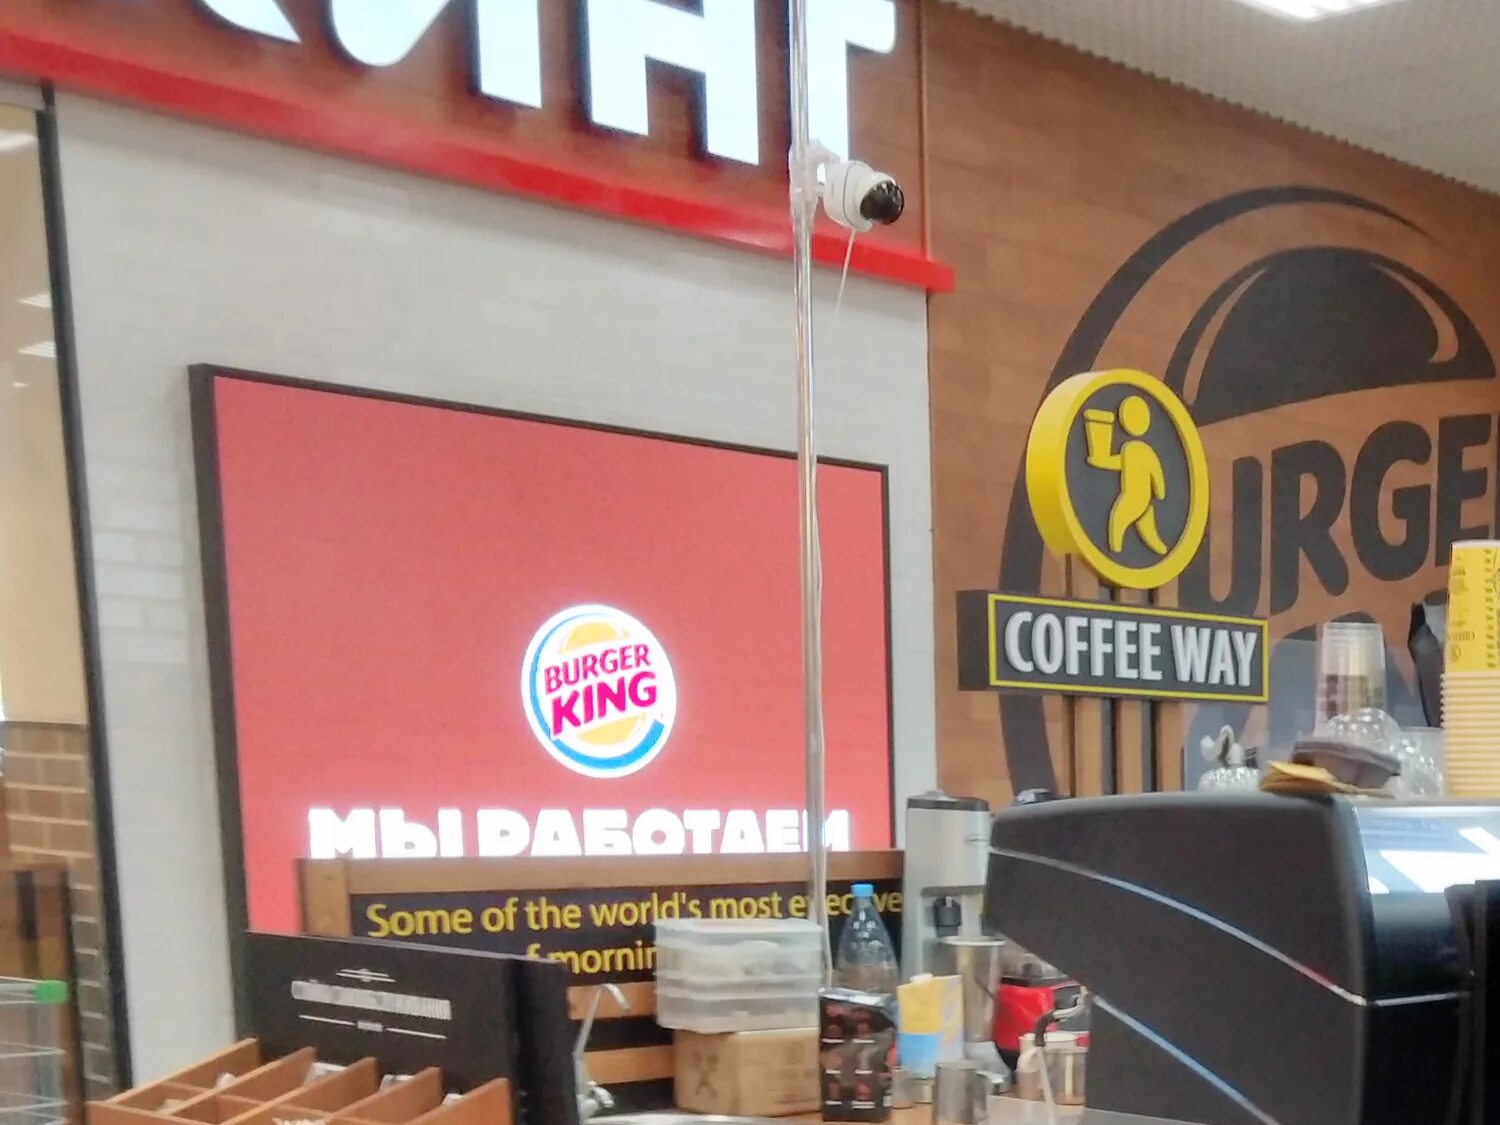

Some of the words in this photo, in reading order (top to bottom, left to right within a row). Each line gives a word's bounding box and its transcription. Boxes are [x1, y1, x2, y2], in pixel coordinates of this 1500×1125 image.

[544, 644, 652, 695] BURGER
[1005, 611, 1163, 680] COFFEE
[1171, 625, 1257, 686] WAY
[552, 671, 657, 736] KING
[308, 808, 463, 858] МЫ
[366, 903, 473, 938] Some
[481, 897, 519, 932] of
[525, 896, 582, 931] the
[589, 891, 702, 926] world's
[710, 891, 783, 919] most
[789, 890, 902, 918] eecve
